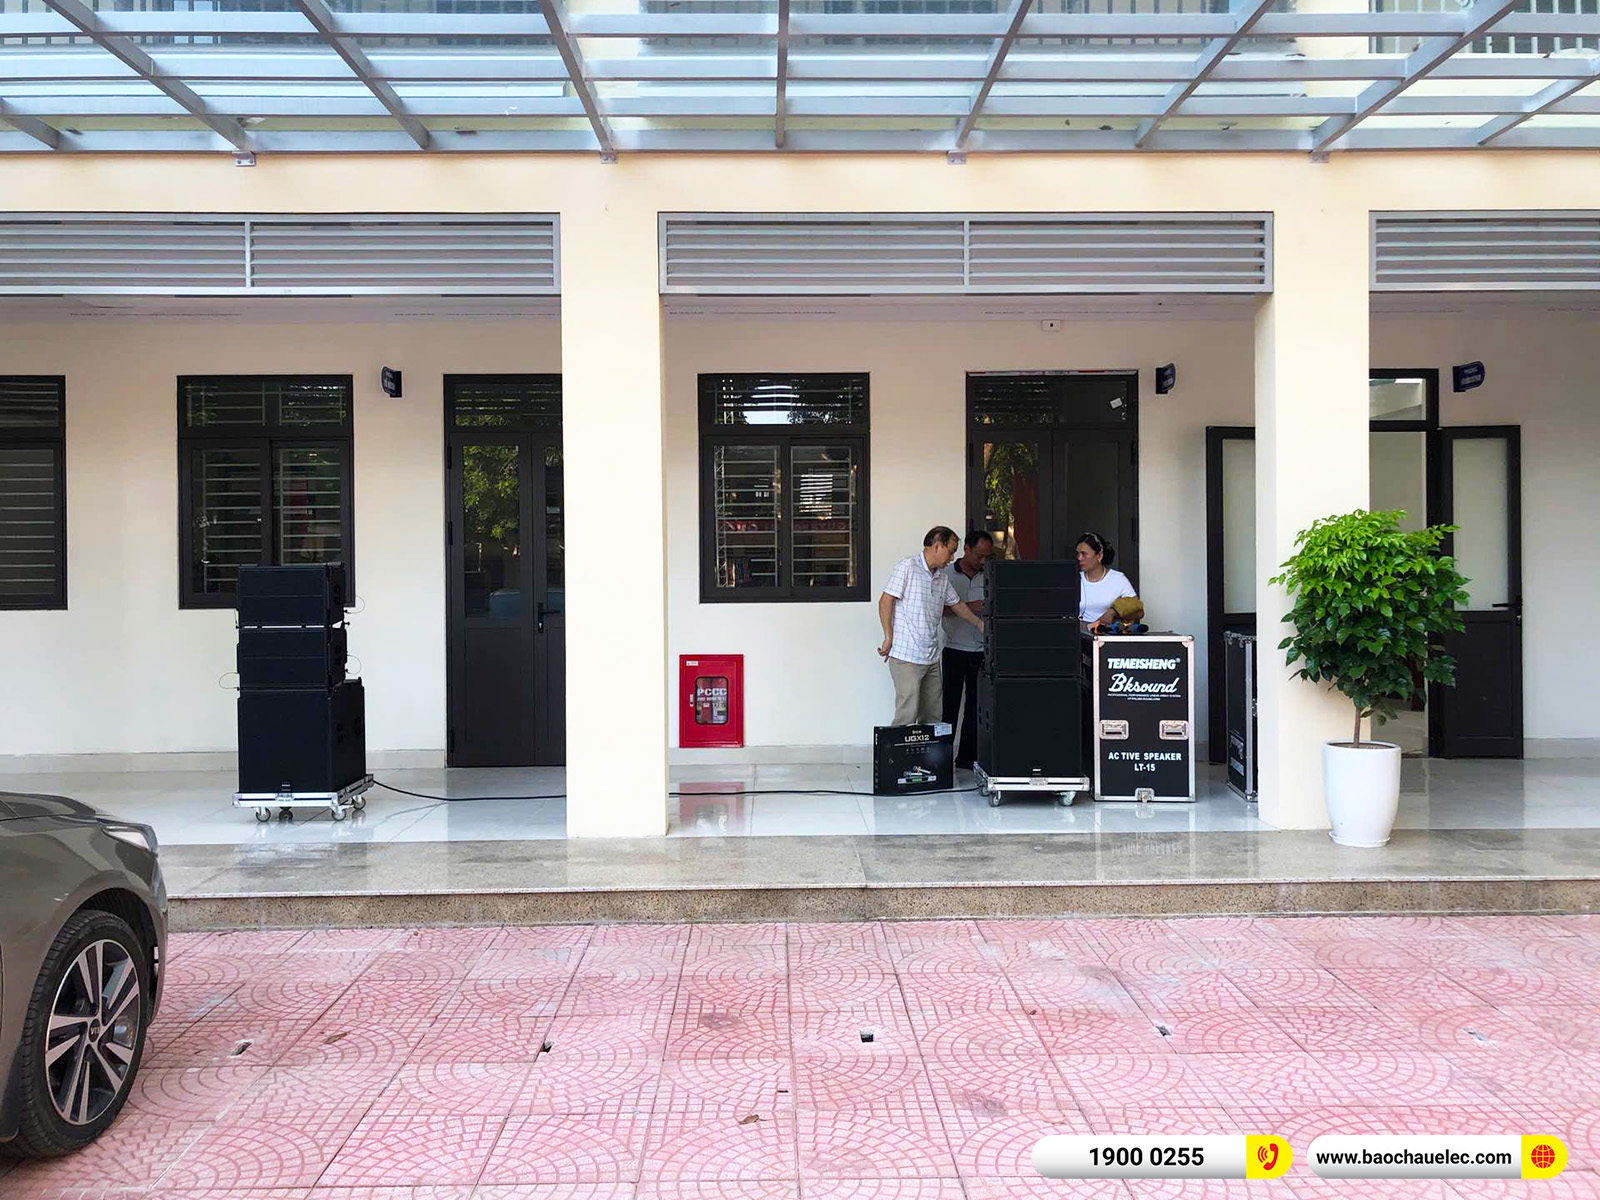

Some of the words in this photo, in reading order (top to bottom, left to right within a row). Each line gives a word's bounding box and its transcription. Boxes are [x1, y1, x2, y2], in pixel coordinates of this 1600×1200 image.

[1107, 658, 1176, 670] TEMEISHENG
[1108, 673, 1180, 693] Bksound
[697, 688, 727, 696] PCCC
[904, 734, 930, 743] UGX12
[1143, 752, 1182, 761] SPEAKER
[1134, 763, 1156, 772] LT-15
